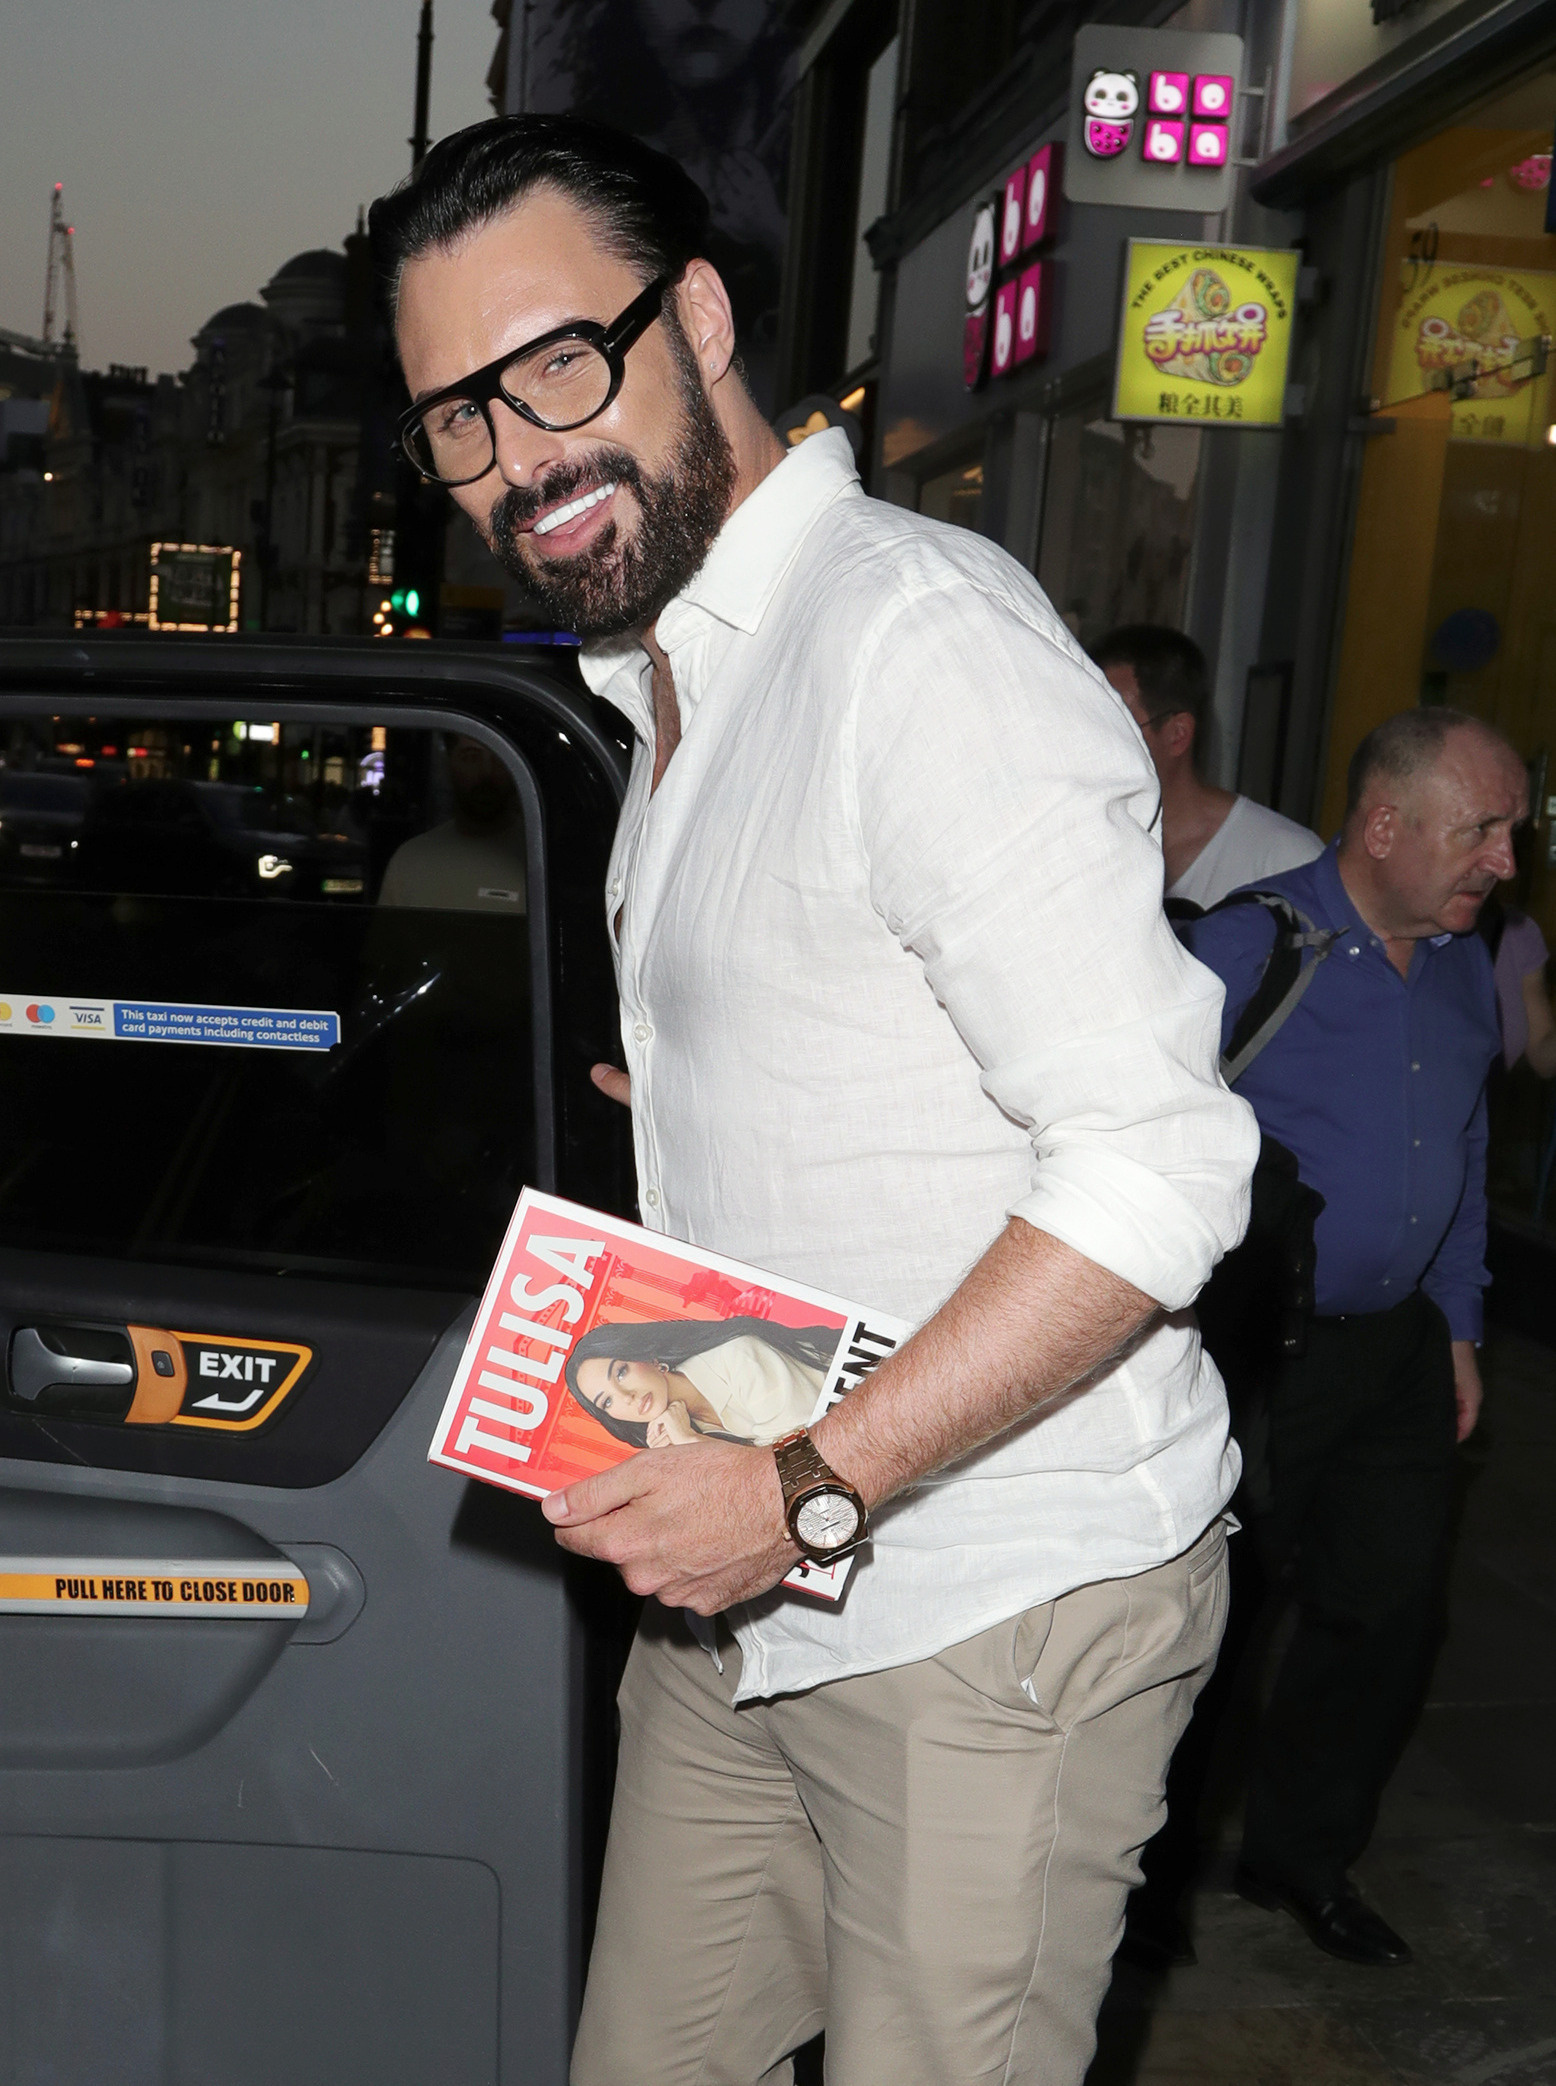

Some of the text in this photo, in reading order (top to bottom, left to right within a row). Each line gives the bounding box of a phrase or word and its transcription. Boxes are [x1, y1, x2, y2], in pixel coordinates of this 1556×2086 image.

[1132, 249, 1288, 320] THE BEST CHINESE WRAPS
[74, 1012, 102, 1024] VISA
[121, 1009, 329, 1031] This taxi now accepts credit and debit
[122, 1022, 320, 1043] card payments including contactless
[454, 1234, 606, 1463] TULISA
[199, 1351, 277, 1384] EXIT
[55, 1578, 295, 1603] PULL HERE TO CLOSE DOOR
